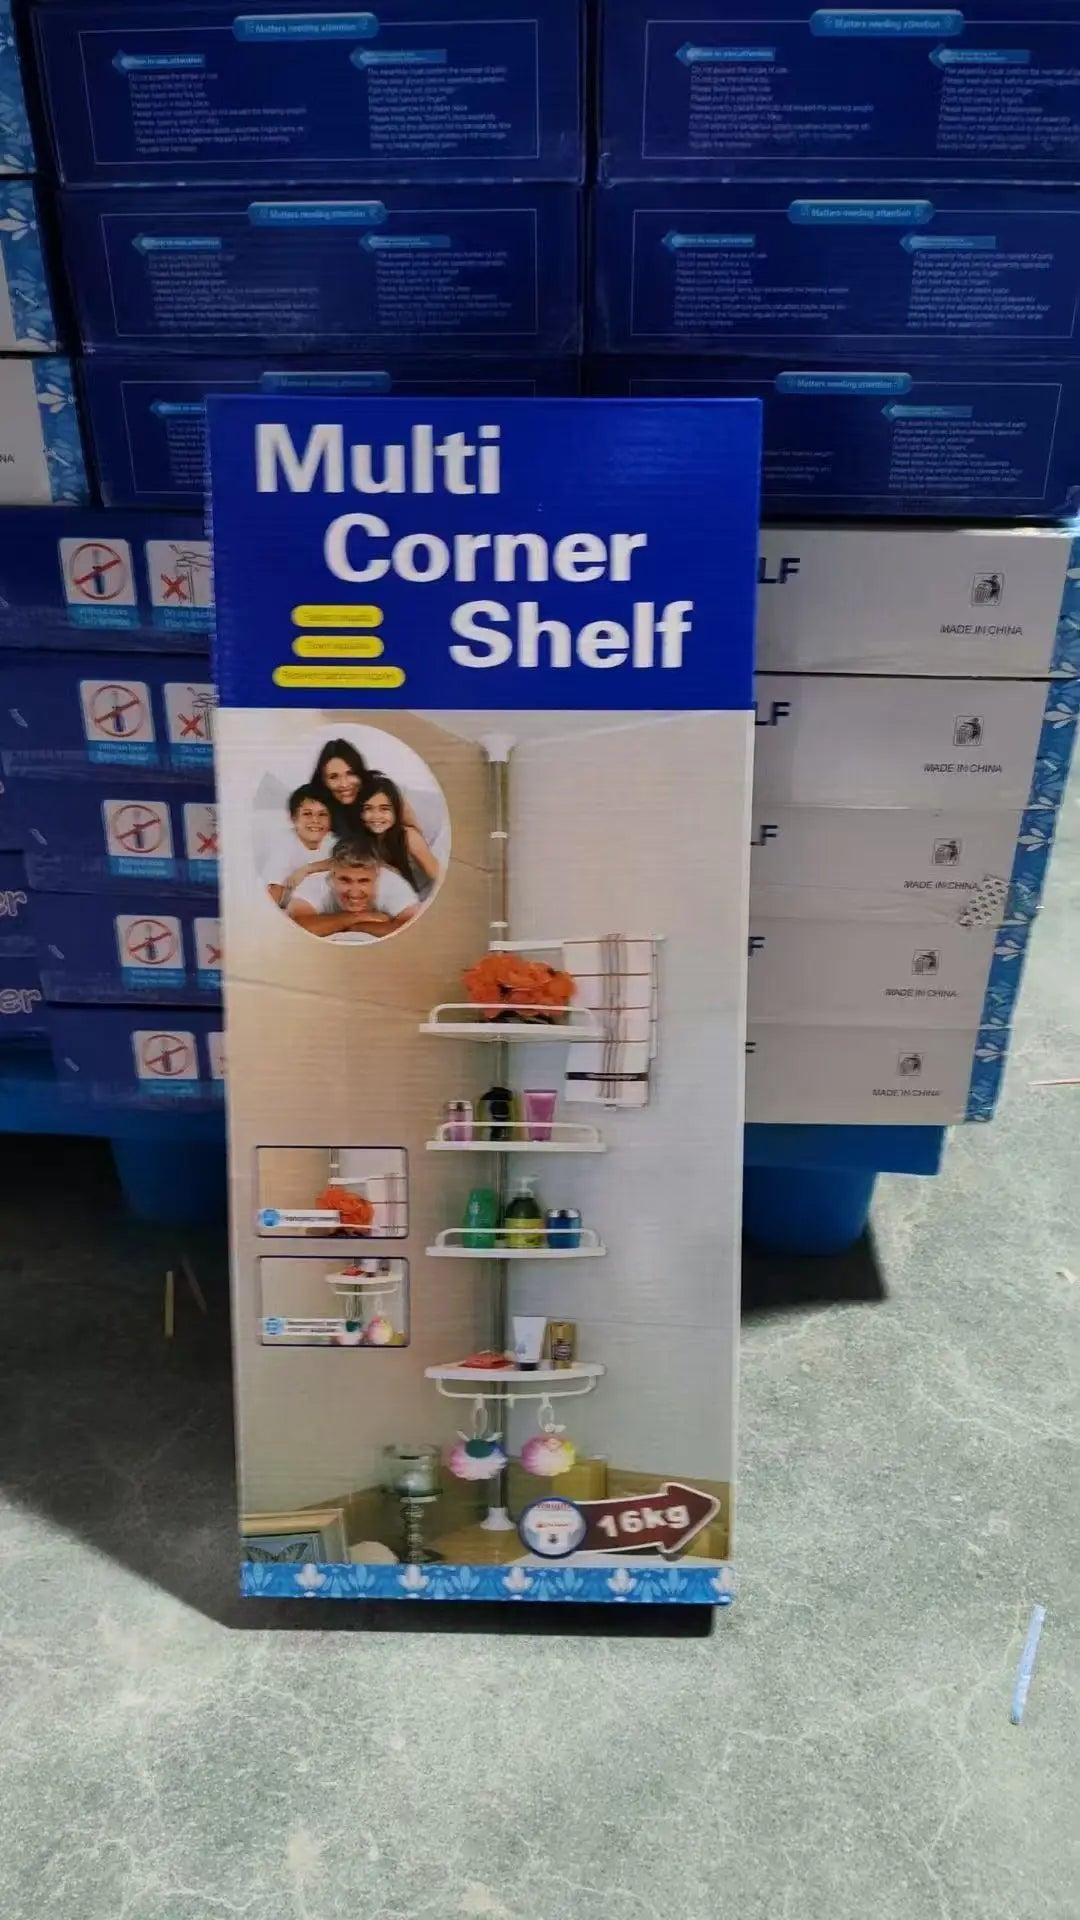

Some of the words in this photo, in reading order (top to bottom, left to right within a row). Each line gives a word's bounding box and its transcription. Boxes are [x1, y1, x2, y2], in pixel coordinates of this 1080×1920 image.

[255, 424, 500, 494] Multi
[323, 512, 648, 583] Corner
[757, 557, 800, 584] LF
[449, 600, 694, 669] Shelf
[940, 624, 972, 634] MADE
[974, 625, 986, 635] IN
[987, 625, 1023, 636] CHINA
[923, 763, 954, 773] MADE
[957, 764, 969, 773] IN
[969, 764, 1002, 773] CHINA
[903, 880, 933, 889] MADE
[935, 881, 947, 889] IN
[947, 882, 979, 890] CHINA
[0, 988, 42, 1014] er
[885, 988, 913, 997] MADE
[915, 990, 926, 998] IN
[927, 990, 958, 998] CHINA
[872, 1088, 899, 1097] MADE
[900, 1089, 911, 1097] IN
[912, 1089, 943, 1097] CHINA
[597, 1504, 691, 1538] 16kg
